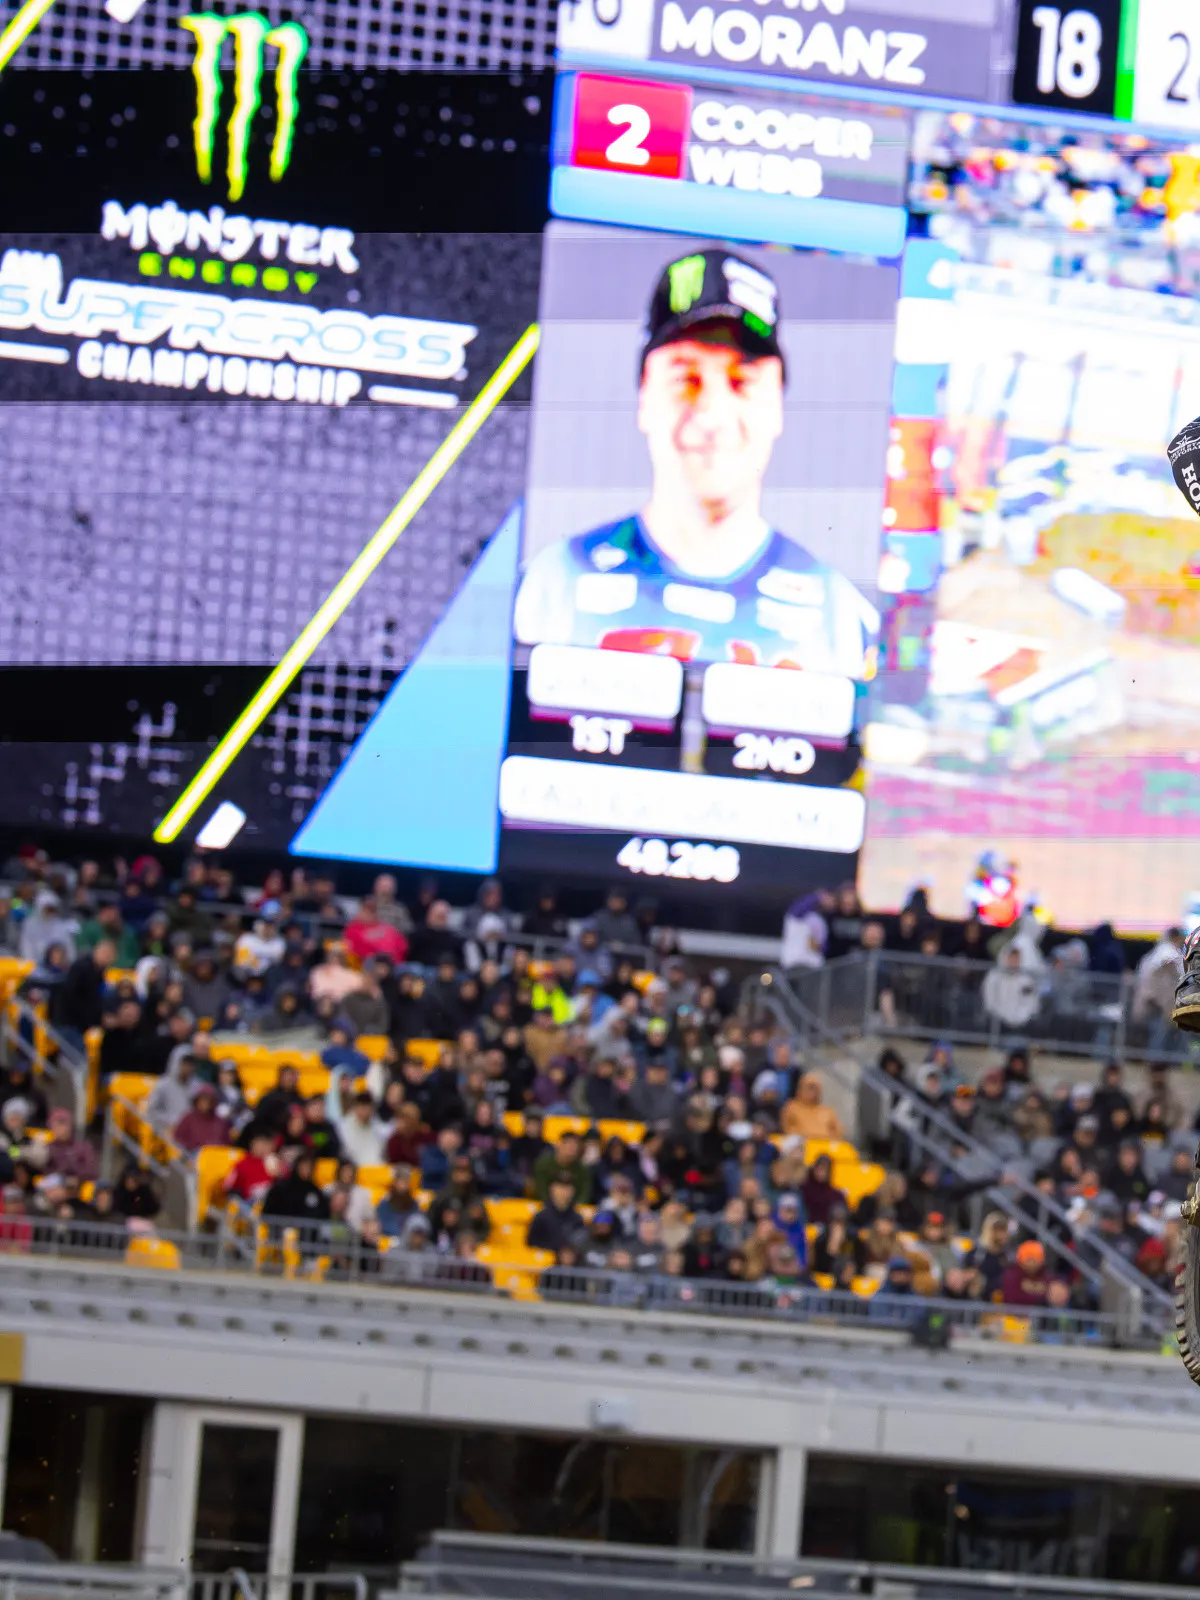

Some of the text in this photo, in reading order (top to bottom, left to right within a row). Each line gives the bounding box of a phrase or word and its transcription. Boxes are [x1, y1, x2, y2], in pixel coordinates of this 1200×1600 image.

[660, 2, 927, 85] MORANZ
[1032, 8, 1102, 97] 18
[604, 103, 651, 166] 2
[691, 102, 873, 160] COOPER
[101, 199, 359, 273] MONSTER
[0, 279, 476, 378] SUPERCROSS
[77, 340, 361, 406] CHAMPIONSHIP
[569, 715, 634, 755] 1ST
[732, 732, 816, 775] 2ND
